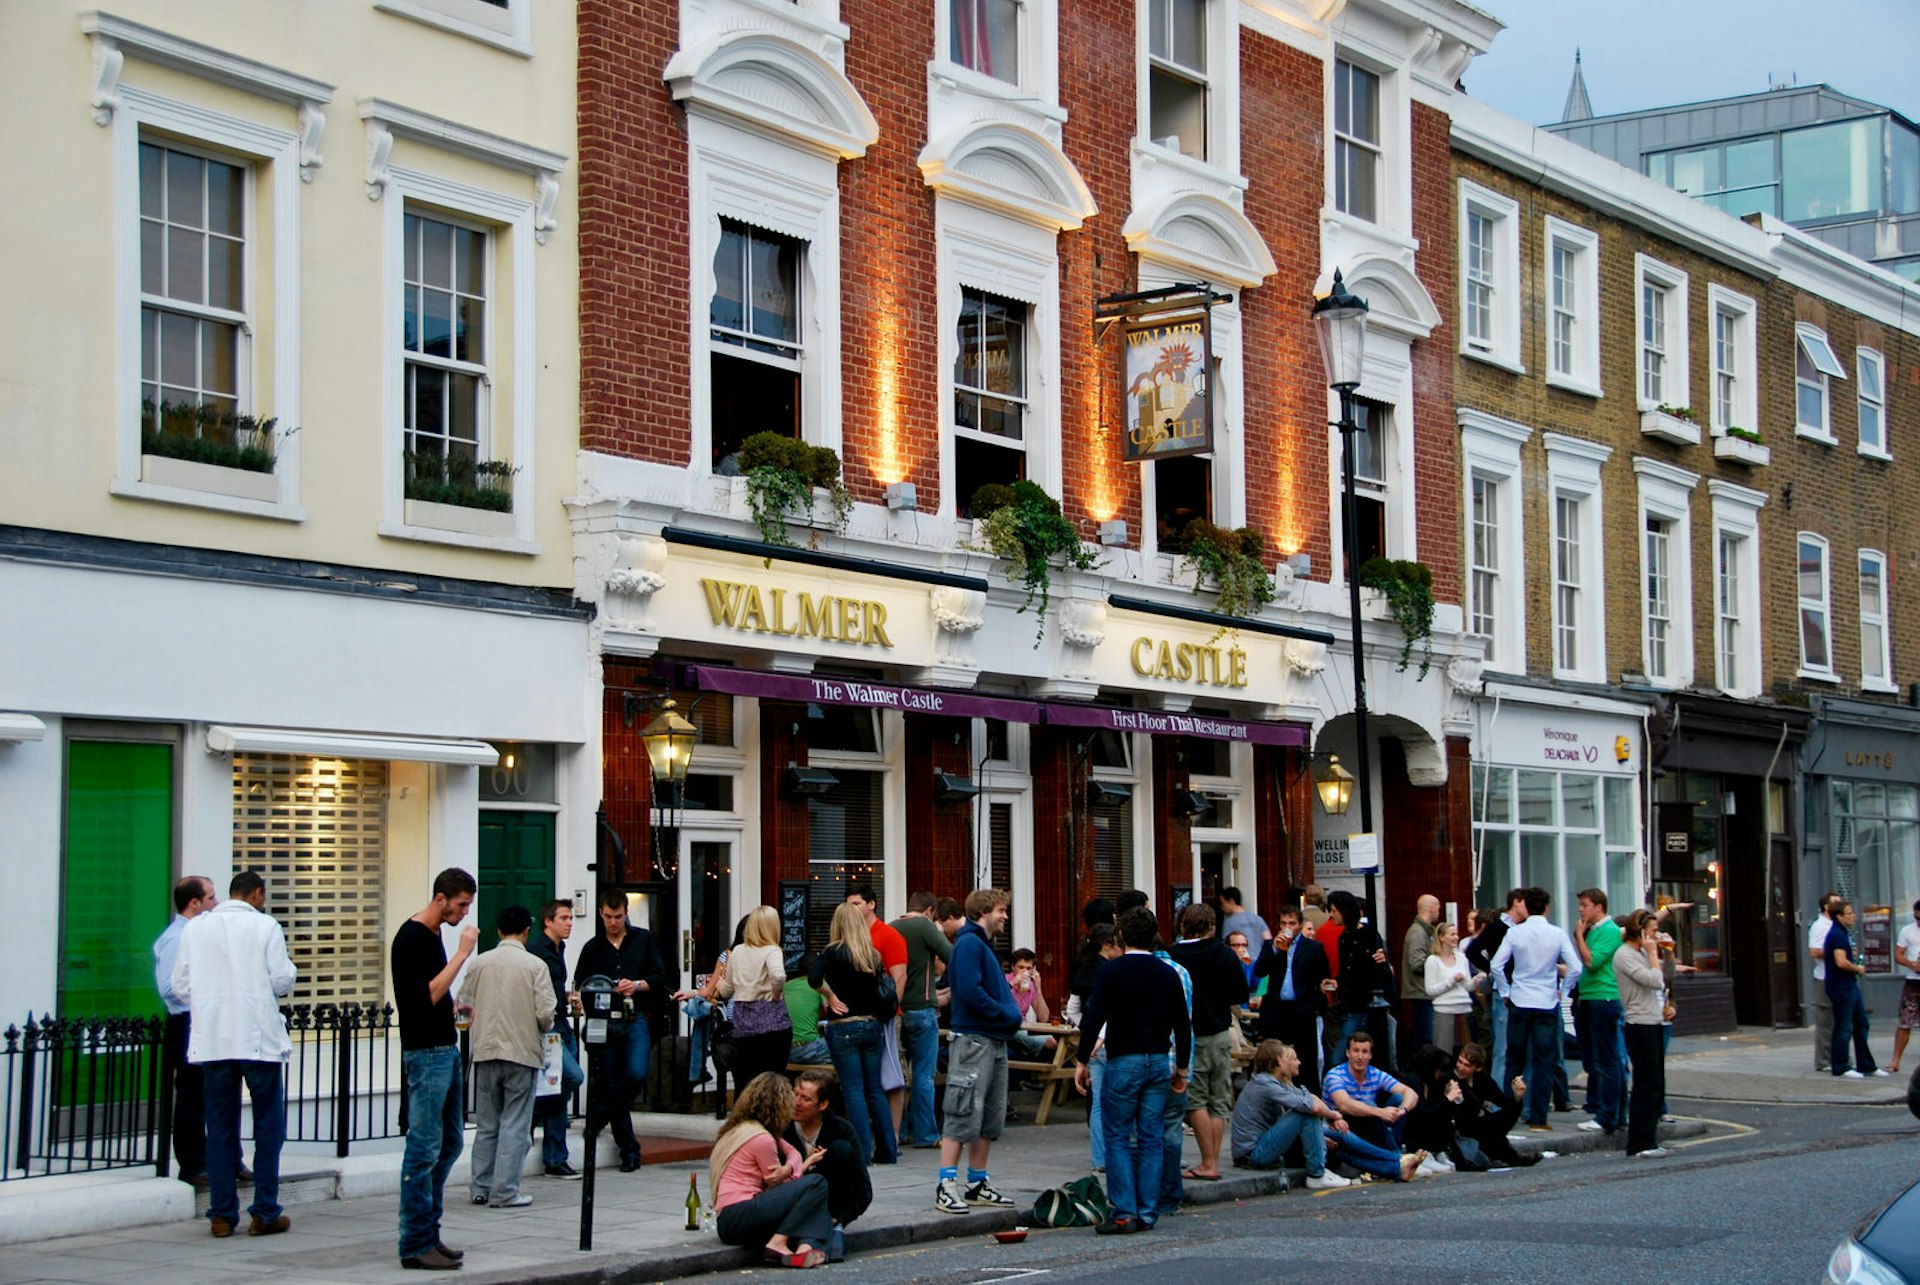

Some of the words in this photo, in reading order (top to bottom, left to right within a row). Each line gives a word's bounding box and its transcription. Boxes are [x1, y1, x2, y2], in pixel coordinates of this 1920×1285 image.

[1127, 323, 1202, 349] WALMER
[1130, 418, 1204, 445] CASTLE
[701, 578, 894, 648] WALMER
[1131, 636, 1248, 688] CASTLE
[812, 679, 842, 700] The
[844, 682, 899, 705] Walmer
[901, 688, 943, 710] Castle
[1112, 710, 1136, 727] First
[1138, 712, 1167, 730] Floor
[1167, 715, 1193, 733] Thai
[1193, 717, 1248, 739] Restaurant
[1314, 839, 1349, 850] WELLIN
[1314, 852, 1344, 863] CLOSE
